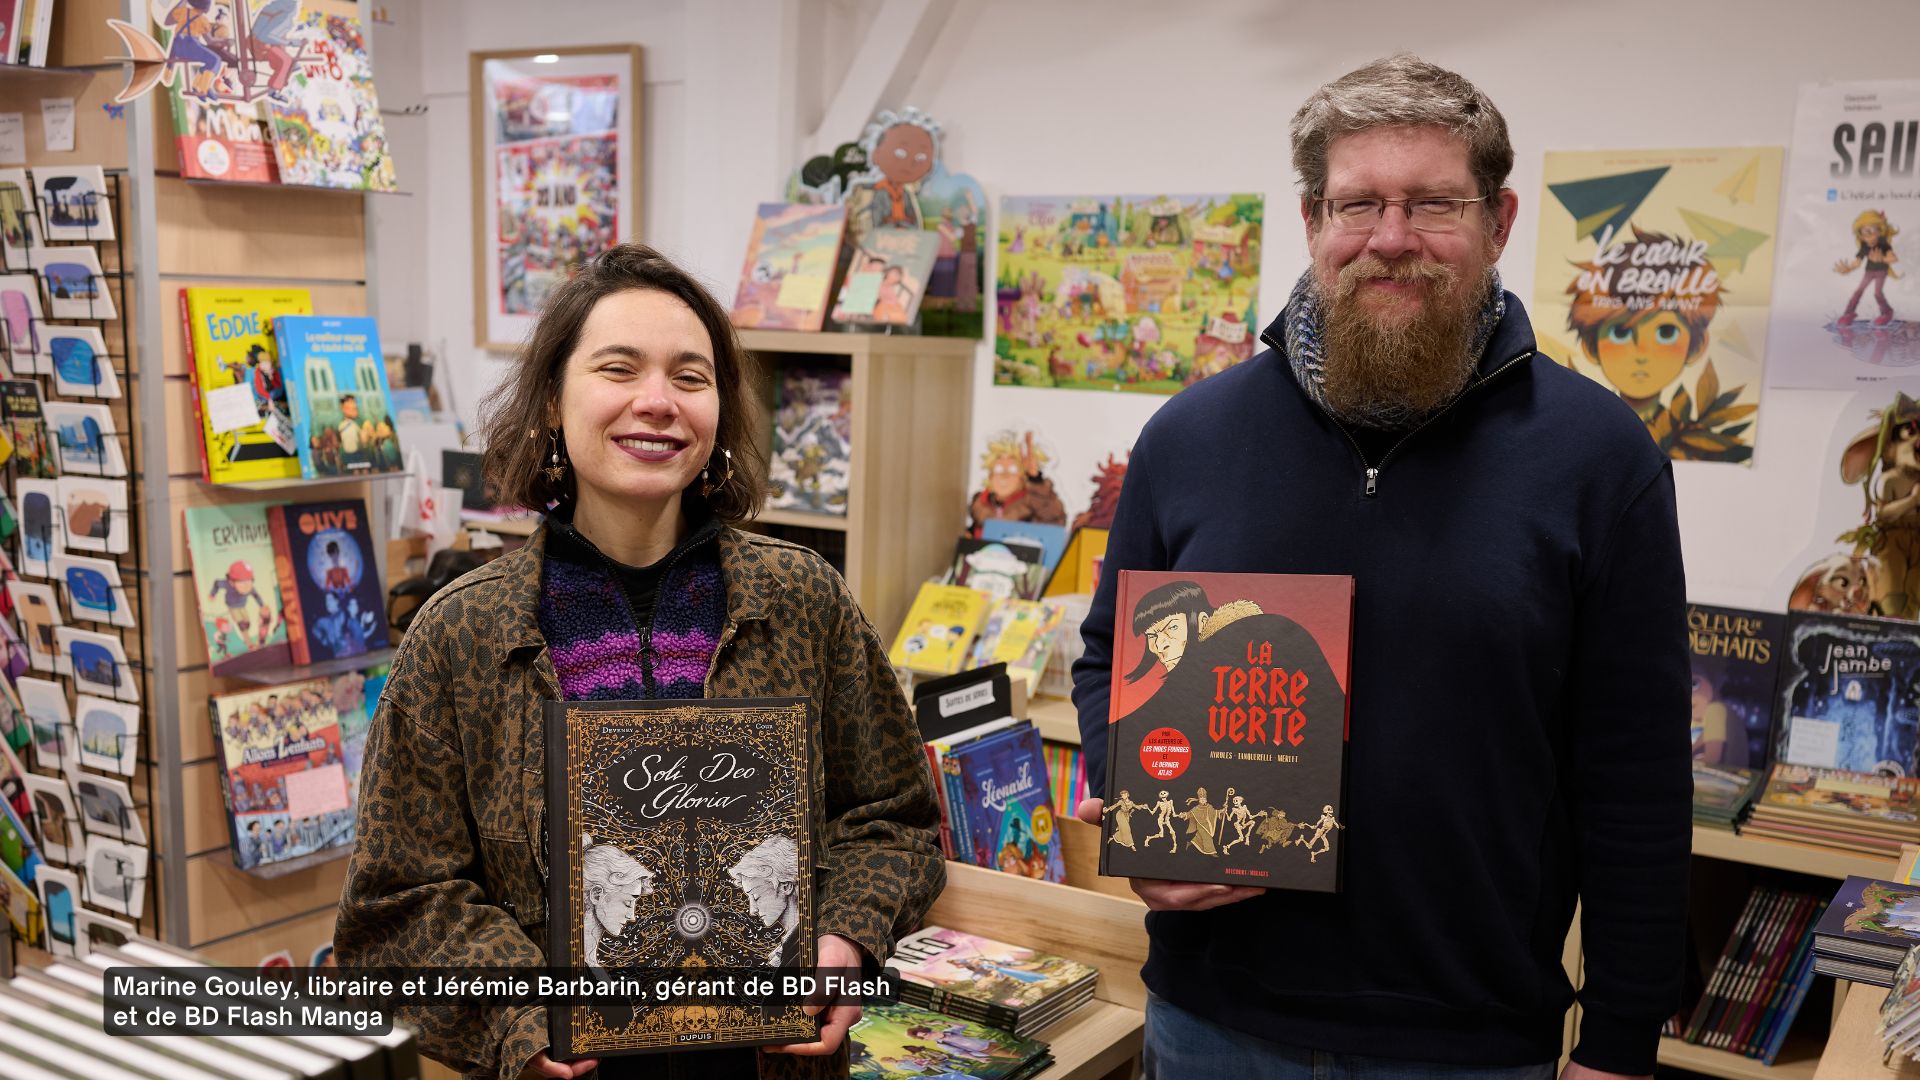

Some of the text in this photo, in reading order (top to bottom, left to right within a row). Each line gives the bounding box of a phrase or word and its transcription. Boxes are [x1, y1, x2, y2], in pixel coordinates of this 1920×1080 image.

[1830, 120, 1920, 178] seu
[1593, 224, 1630, 265] Le
[206, 312, 261, 341] EDDIE
[298, 509, 358, 534] OLIVE
[1247, 640, 1272, 665] LA
[1211, 666, 1309, 707] TERRE
[1208, 705, 1307, 747] VERTE
[623, 753, 755, 791] Soli Deo
[640, 782, 746, 819] Gloria
[680, 1032, 713, 1042] DUPUIS
